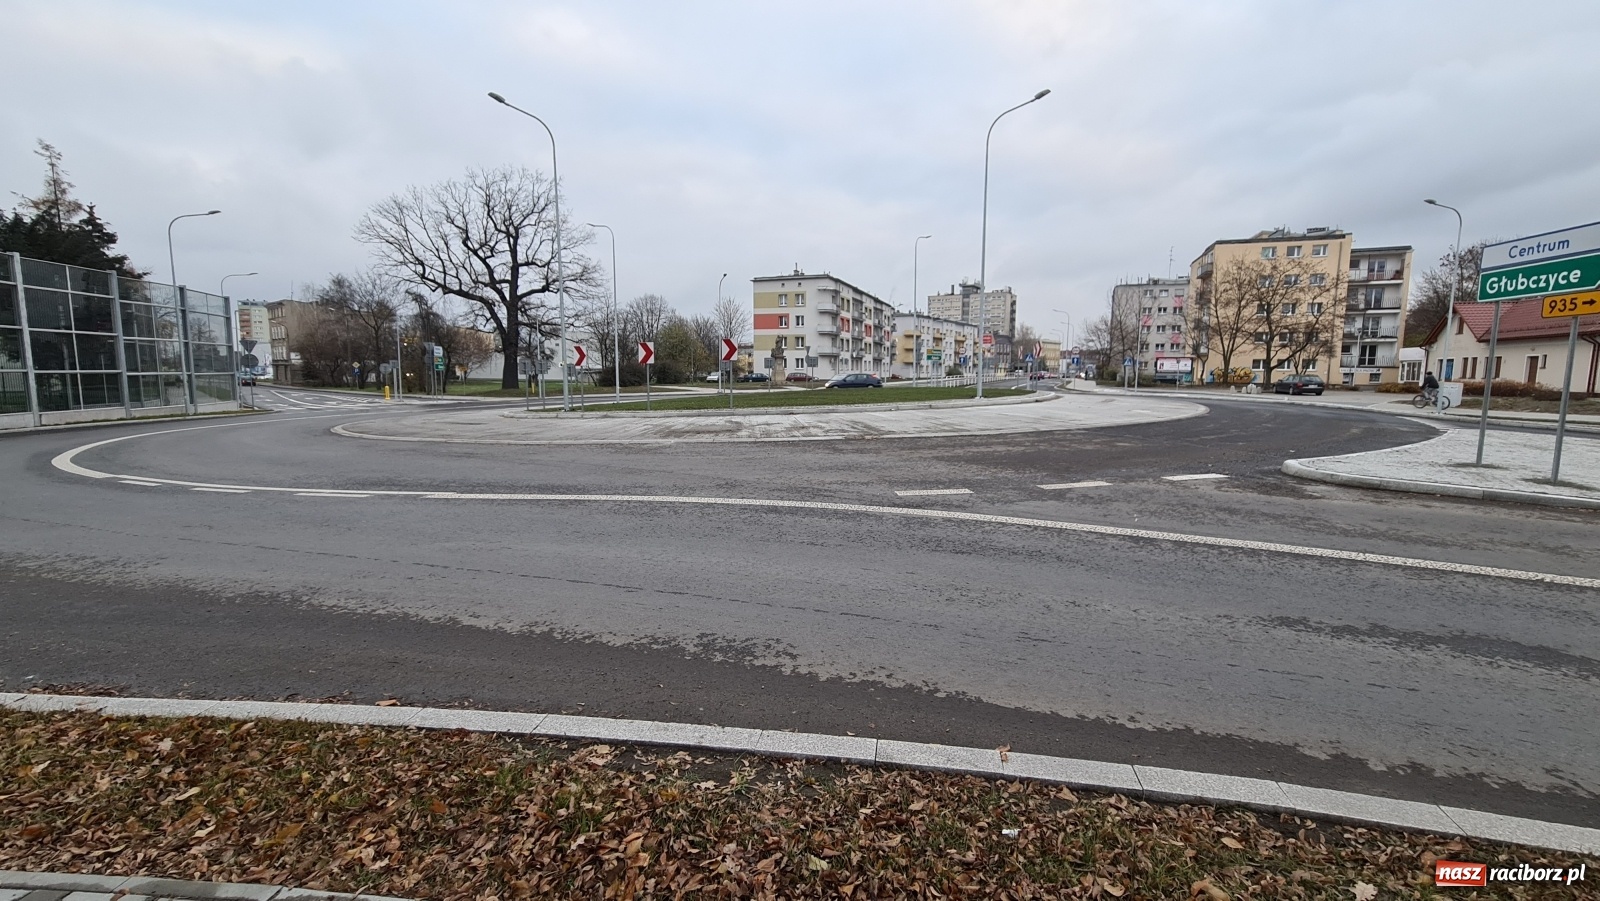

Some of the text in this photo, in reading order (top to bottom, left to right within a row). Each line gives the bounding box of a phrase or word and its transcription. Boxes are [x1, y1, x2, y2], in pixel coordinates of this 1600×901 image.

[1508, 239, 1570, 258] Centrum
[1486, 269, 1581, 293] Głubczyce
[1548, 297, 1578, 314] 935
